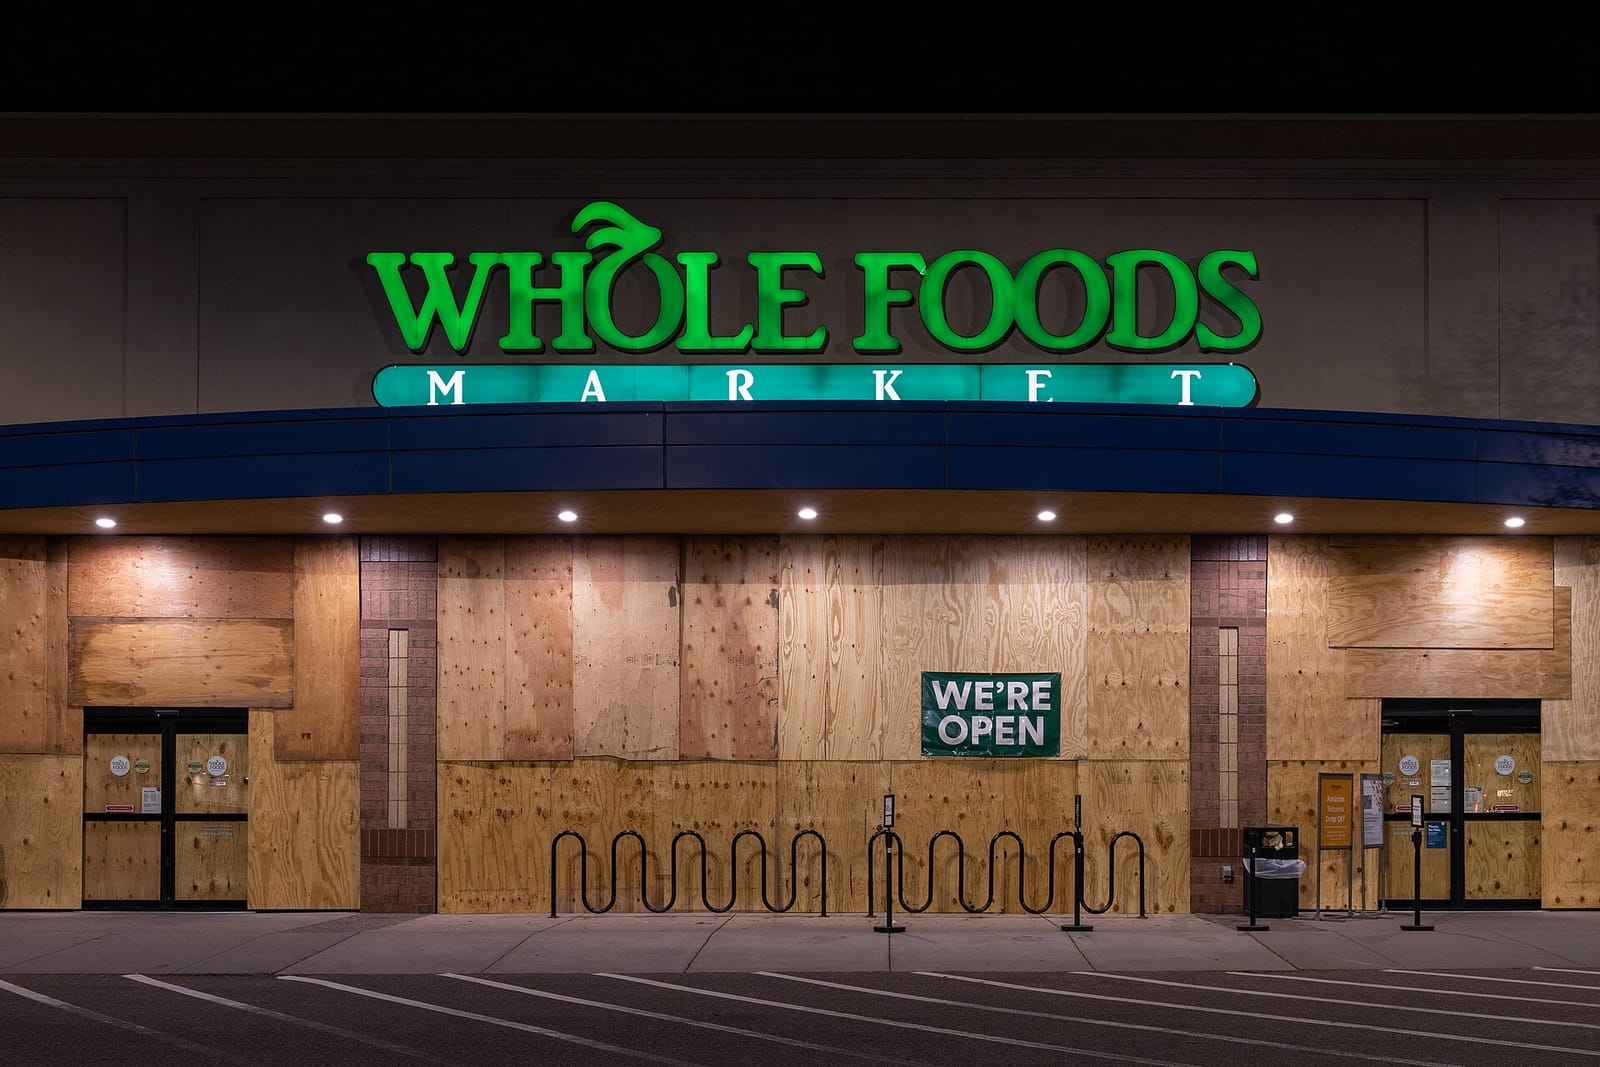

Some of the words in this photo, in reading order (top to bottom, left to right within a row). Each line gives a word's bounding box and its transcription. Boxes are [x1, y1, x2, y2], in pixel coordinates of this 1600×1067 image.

[366, 203, 826, 352] WHOLE
[852, 249, 1263, 353] FOODS
[427, 369, 1201, 407] MARKET
[931, 680, 1052, 711] WE’RE
[938, 714, 1045, 746] OPEN
